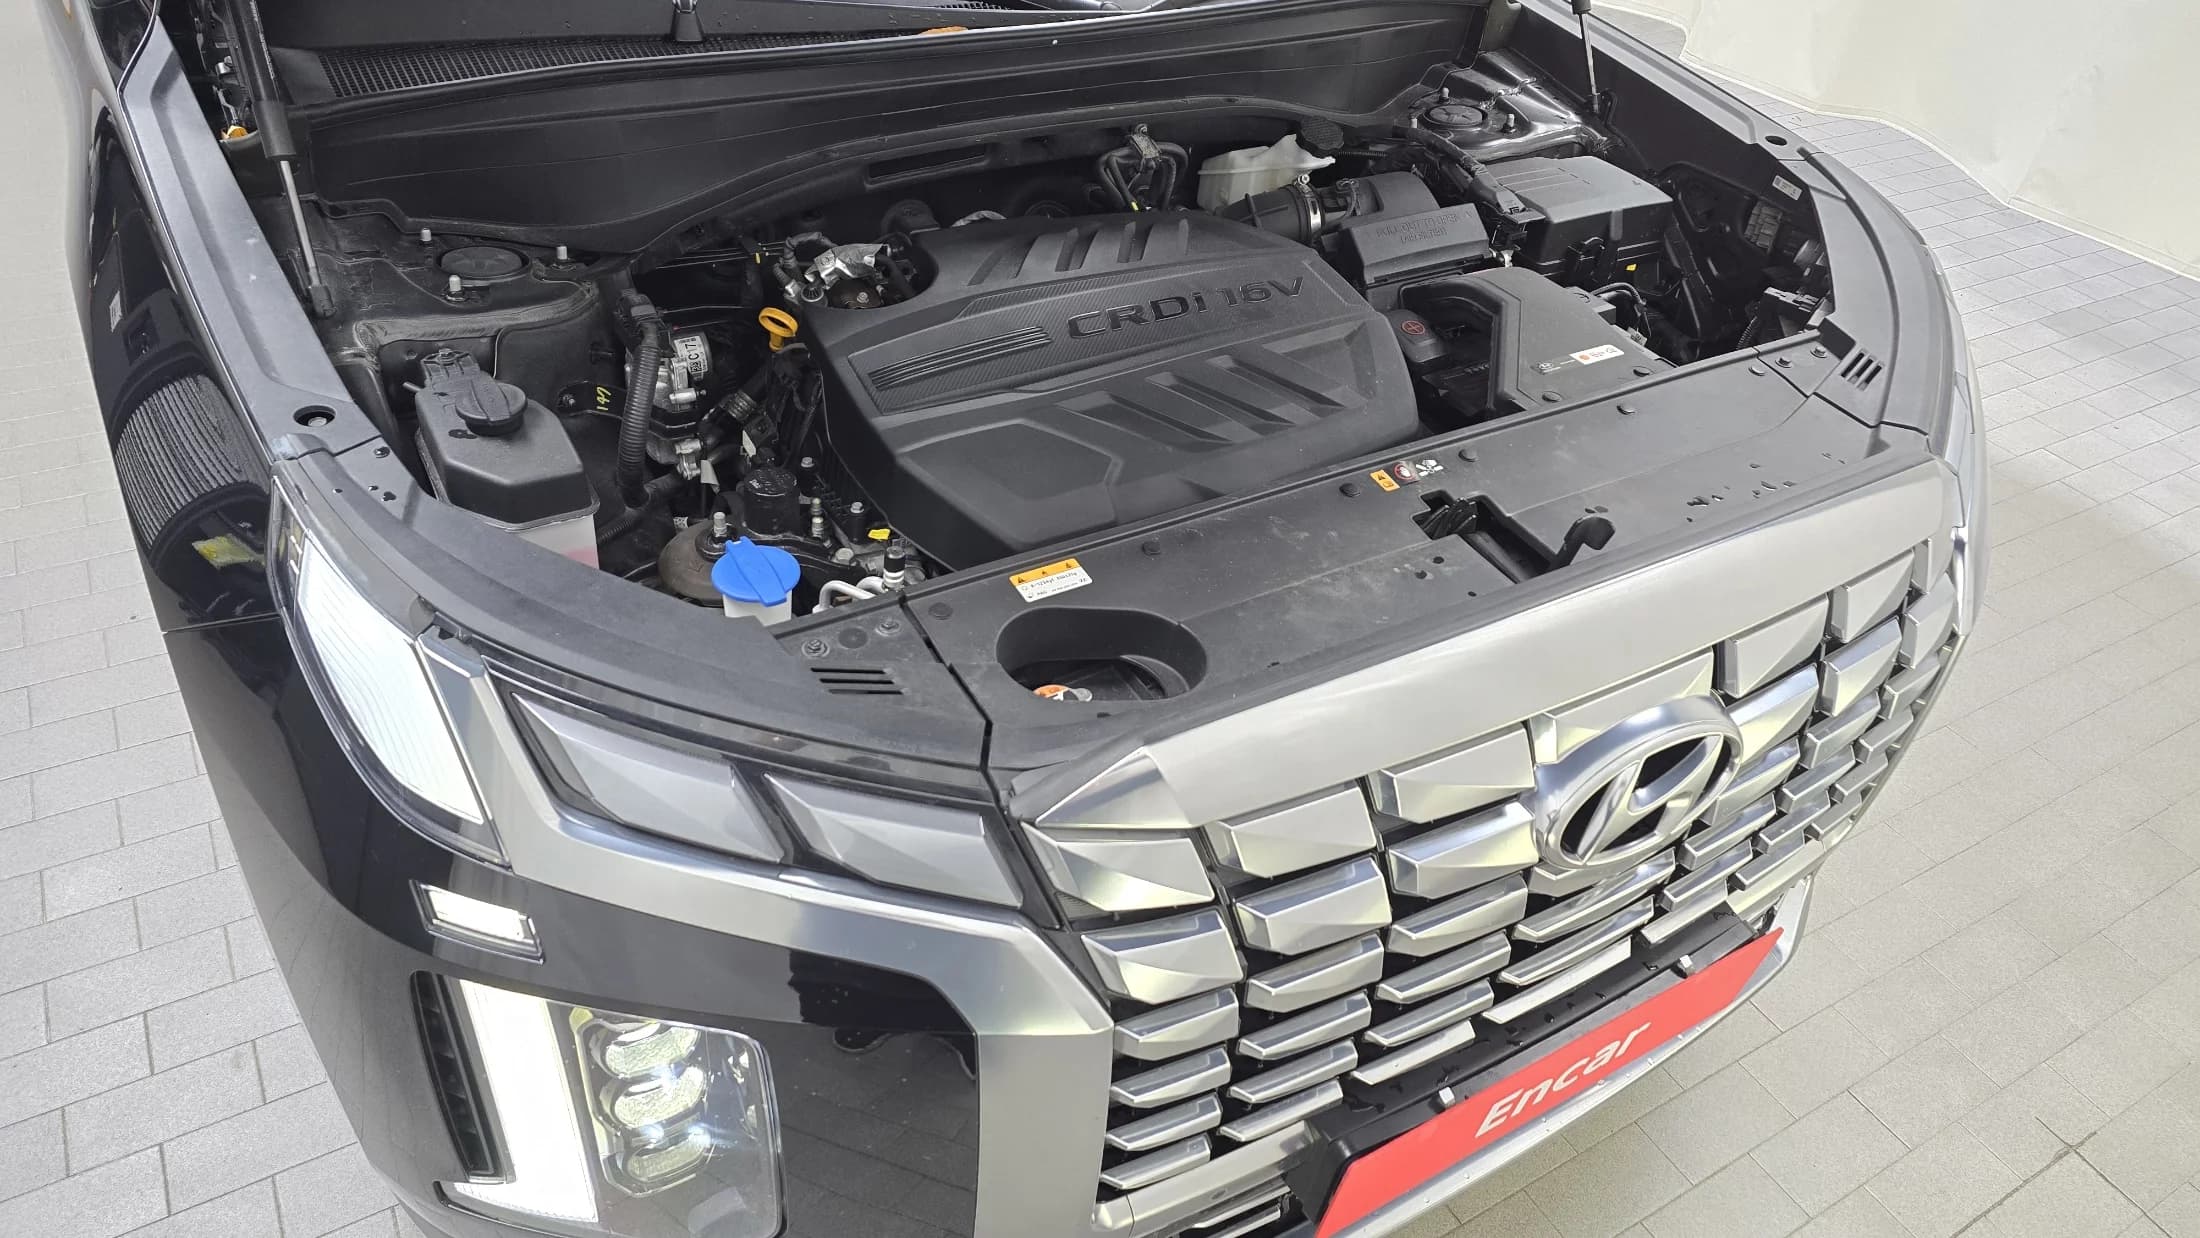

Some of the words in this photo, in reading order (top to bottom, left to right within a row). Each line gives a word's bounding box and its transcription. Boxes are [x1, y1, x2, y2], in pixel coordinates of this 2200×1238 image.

[1067, 291, 1208, 339] CRDi
[1216, 277, 1304, 307] 16V
[1475, 1022, 1652, 1138] Encar
